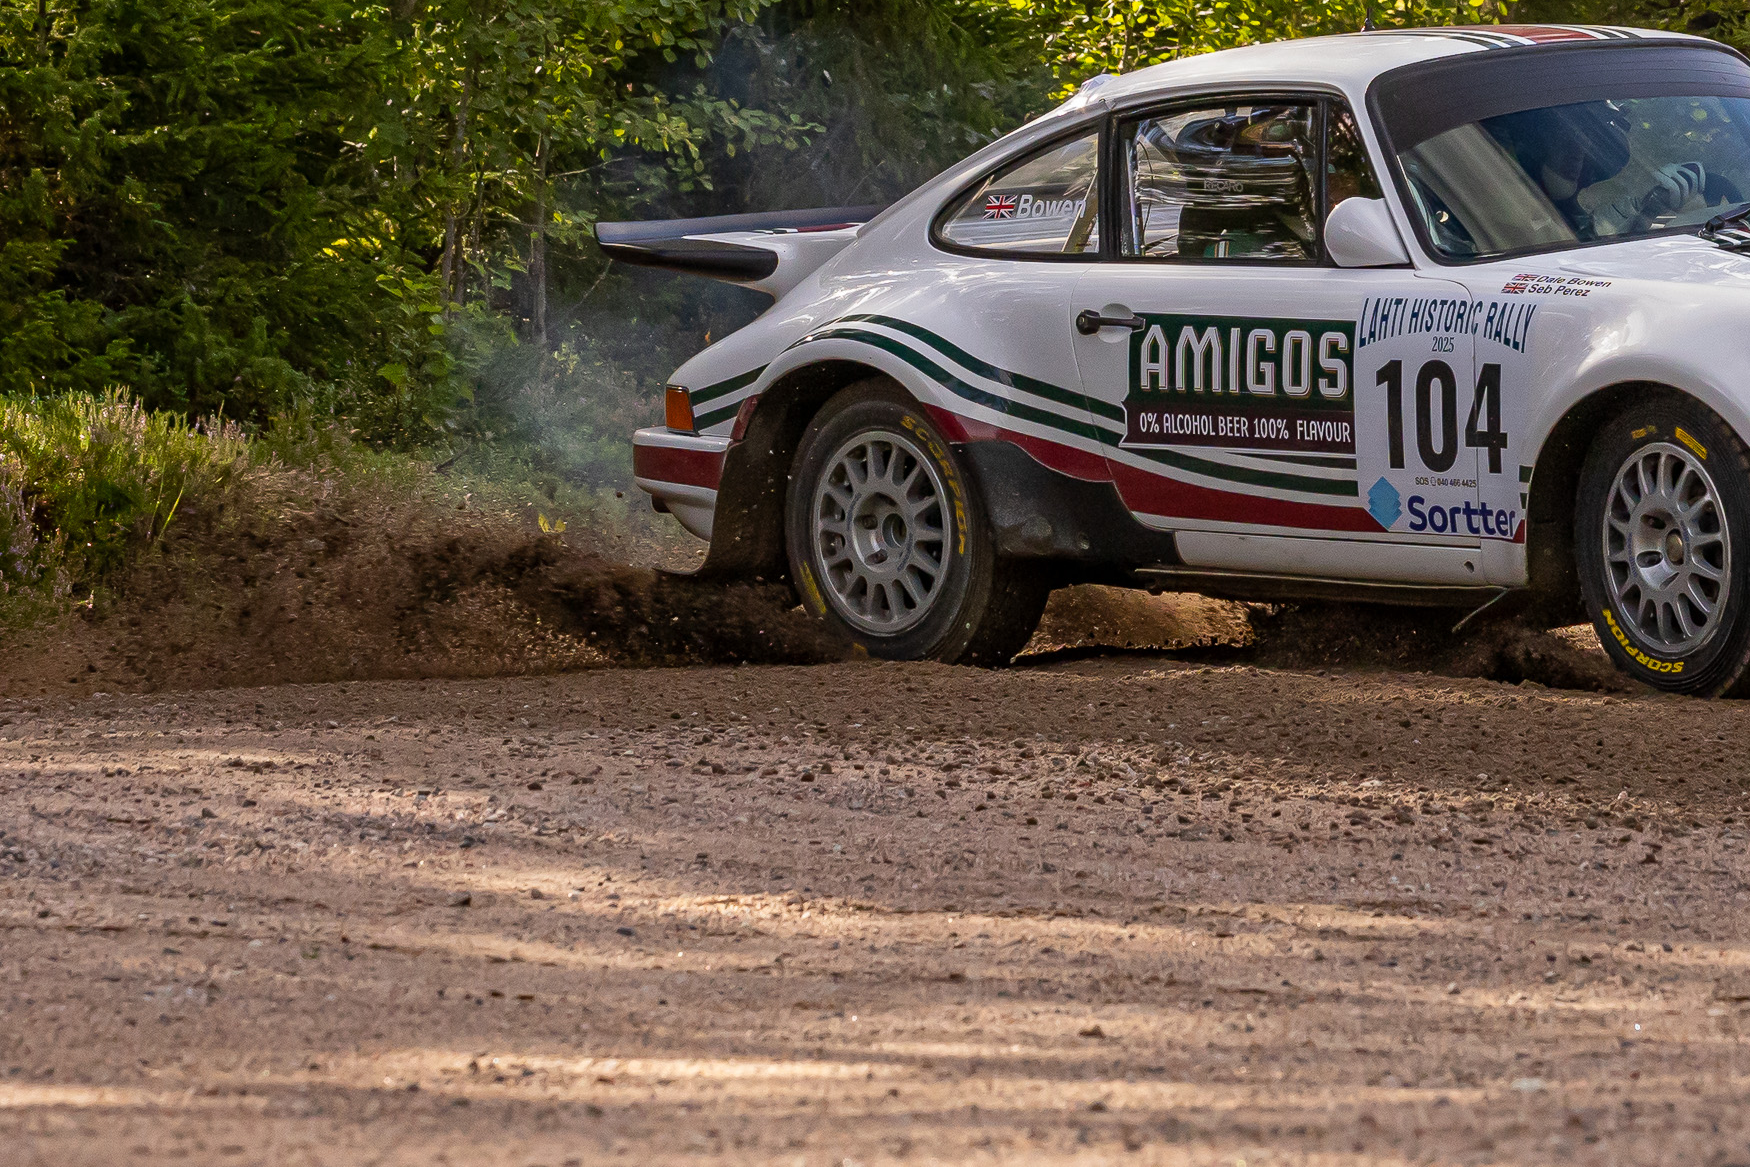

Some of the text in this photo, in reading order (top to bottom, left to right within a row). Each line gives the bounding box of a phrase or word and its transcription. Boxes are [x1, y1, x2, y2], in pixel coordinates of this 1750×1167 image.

[1204, 179, 1243, 192] RECARO
[1016, 194, 1087, 219] Bowen
[1528, 283, 1591, 296] Seb Perez
[1536, 275, 1612, 288] Dale Bowen
[1359, 297, 1537, 354] LAHTI HISTORIC RALLY
[1431, 336, 1455, 352] 2025
[1140, 324, 1350, 399] AMIGOS
[1140, 412, 1351, 443] 0% ALCOHOL BEER 100% FLAVOUR
[1375, 359, 1508, 474] 104
[1415, 476, 1429, 486] SOS
[1407, 494, 1516, 537] Sortter
[1602, 609, 1684, 673] SCORPION
